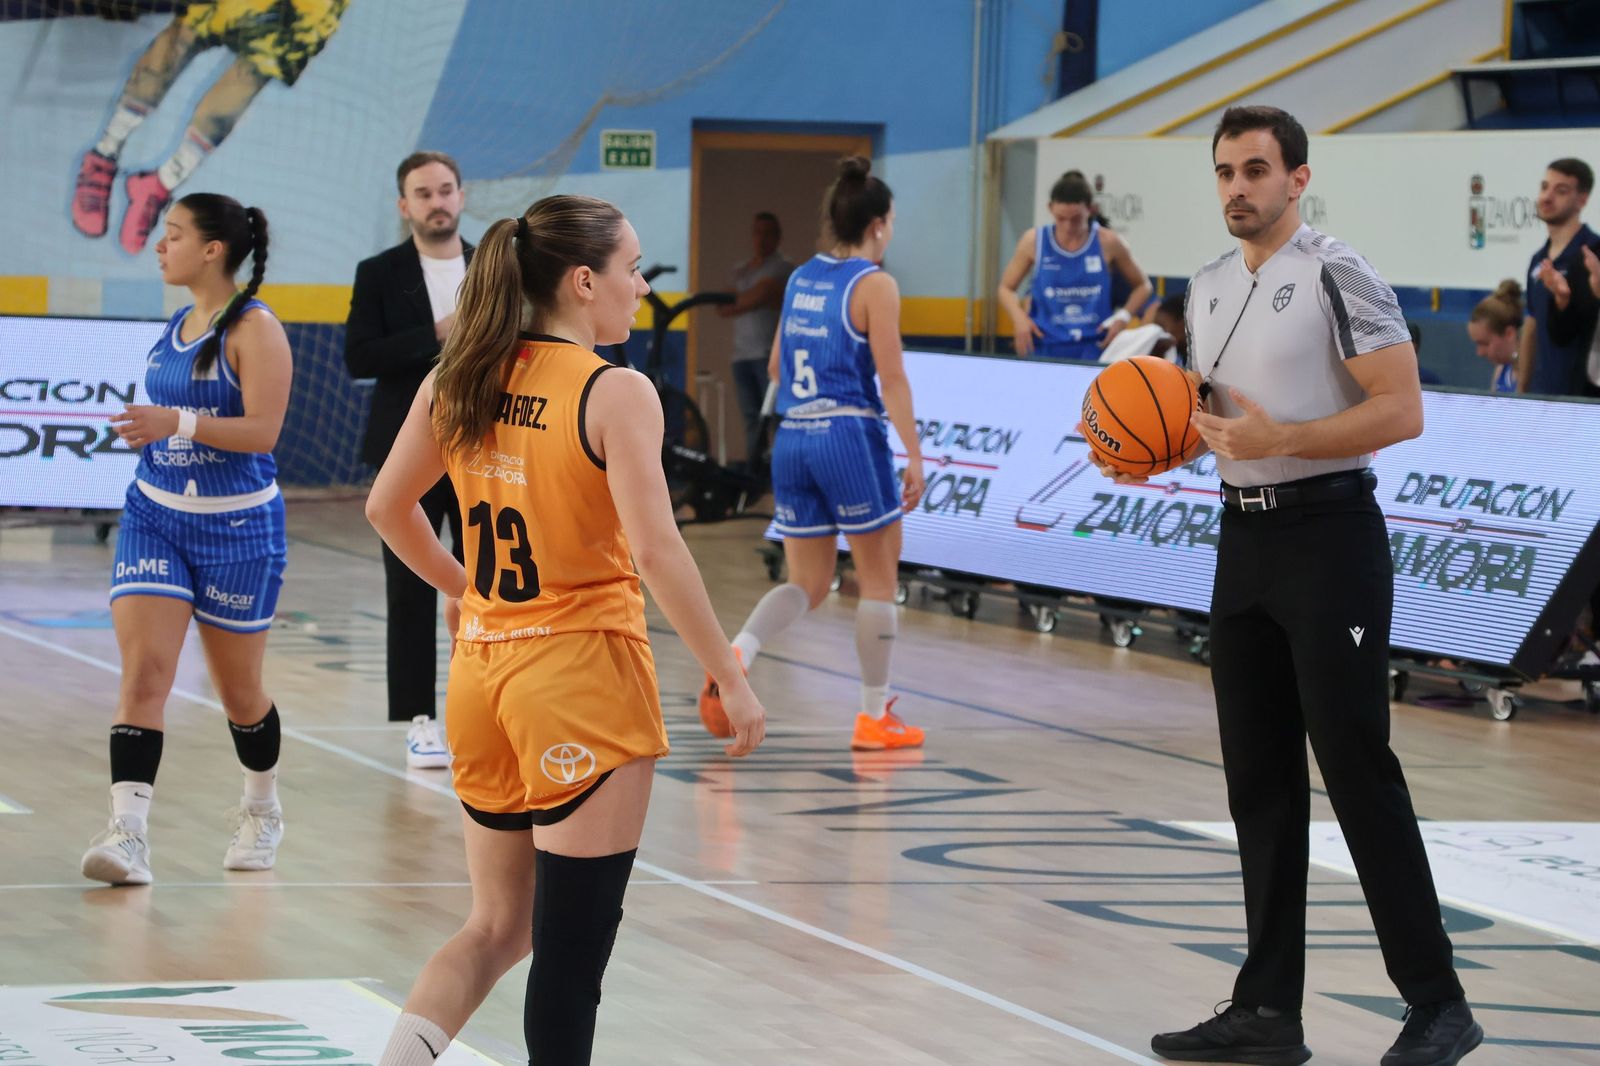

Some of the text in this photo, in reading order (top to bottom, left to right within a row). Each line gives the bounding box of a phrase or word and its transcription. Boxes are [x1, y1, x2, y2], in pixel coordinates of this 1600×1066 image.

[791, 349, 818, 399] 5
[511, 394, 549, 431] FDEZ.
[468, 500, 541, 603] 13
